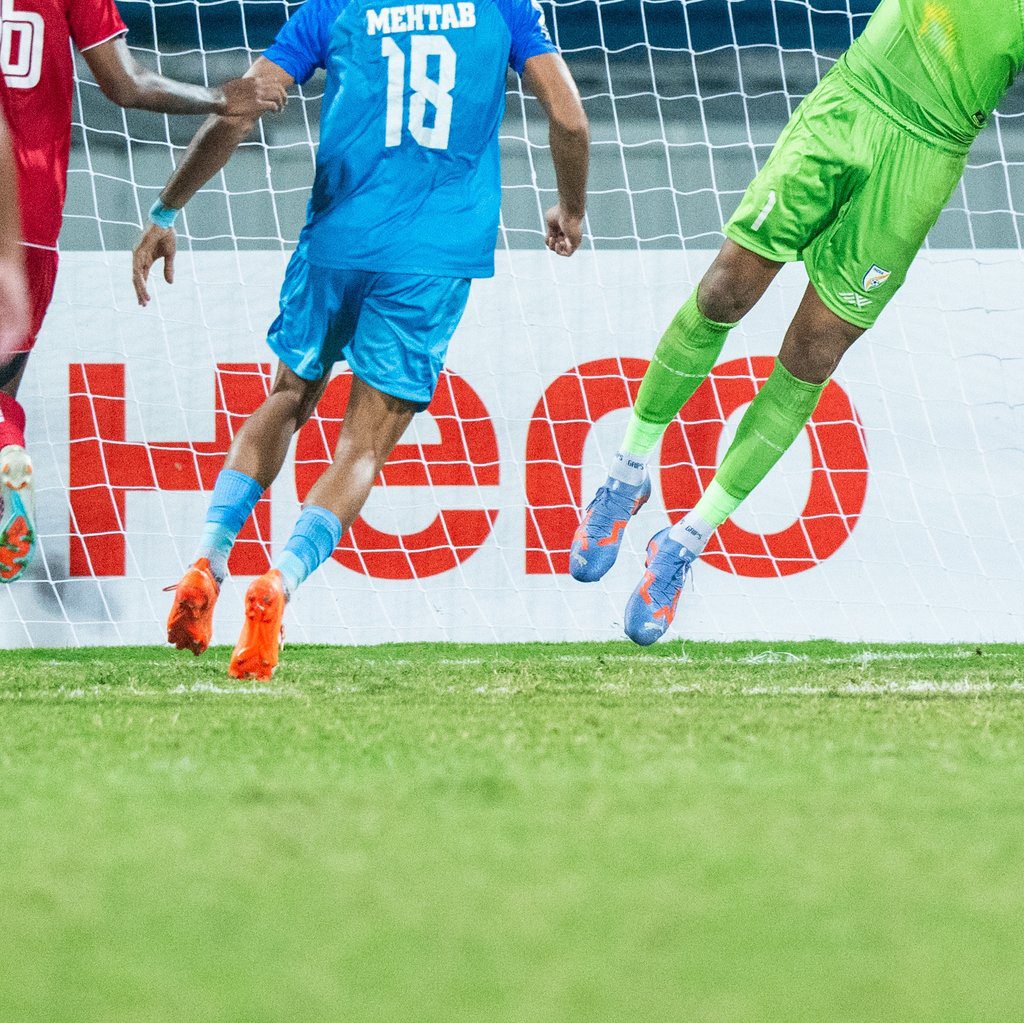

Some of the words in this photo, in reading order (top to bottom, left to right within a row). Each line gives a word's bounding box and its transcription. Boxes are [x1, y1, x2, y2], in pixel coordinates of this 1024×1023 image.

[366, 2, 477, 36] MEHTAB
[381, 34, 457, 150] 18
[750, 190, 776, 232] 1
[69, 356, 869, 580] Hero
